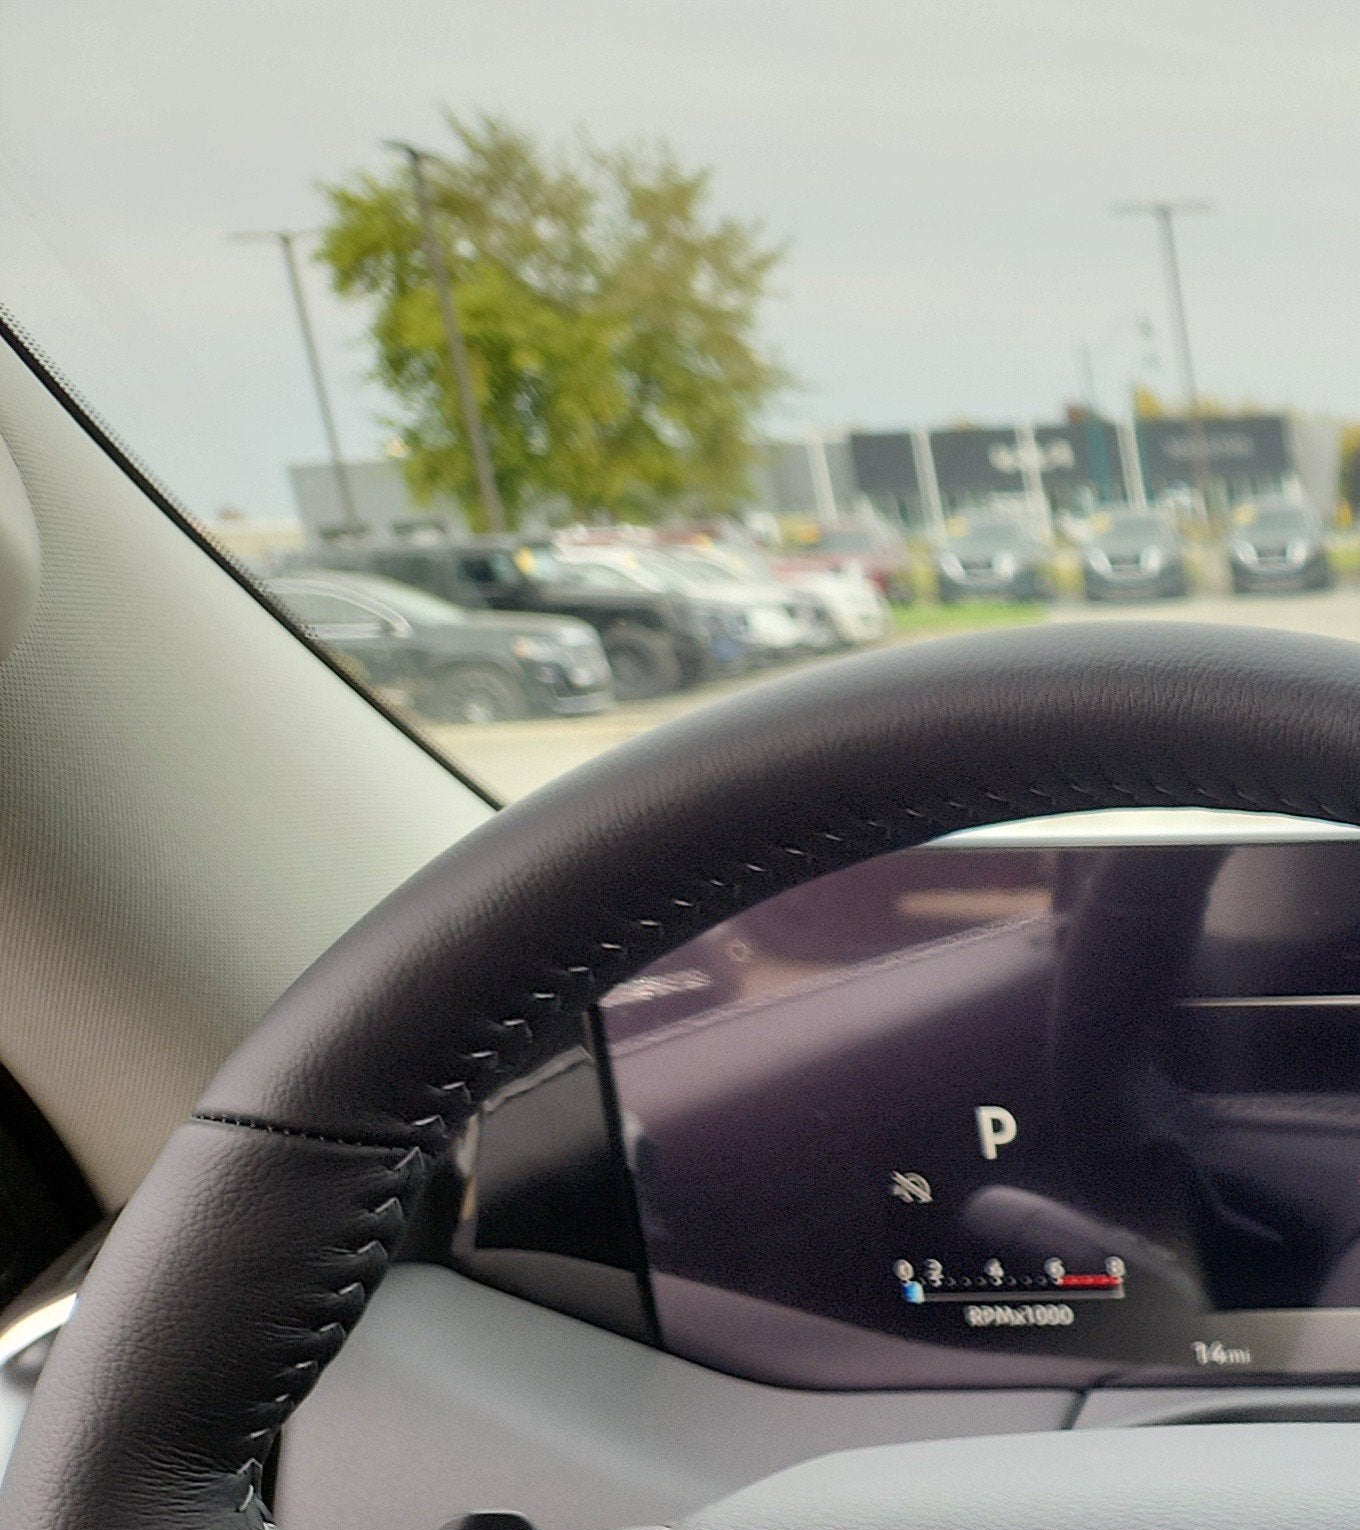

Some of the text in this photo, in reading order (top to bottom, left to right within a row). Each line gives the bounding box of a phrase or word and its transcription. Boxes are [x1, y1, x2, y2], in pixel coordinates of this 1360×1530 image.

[974, 1105, 1018, 1160] P
[985, 1257, 1004, 1279] 4
[1044, 1256, 1066, 1278] 6
